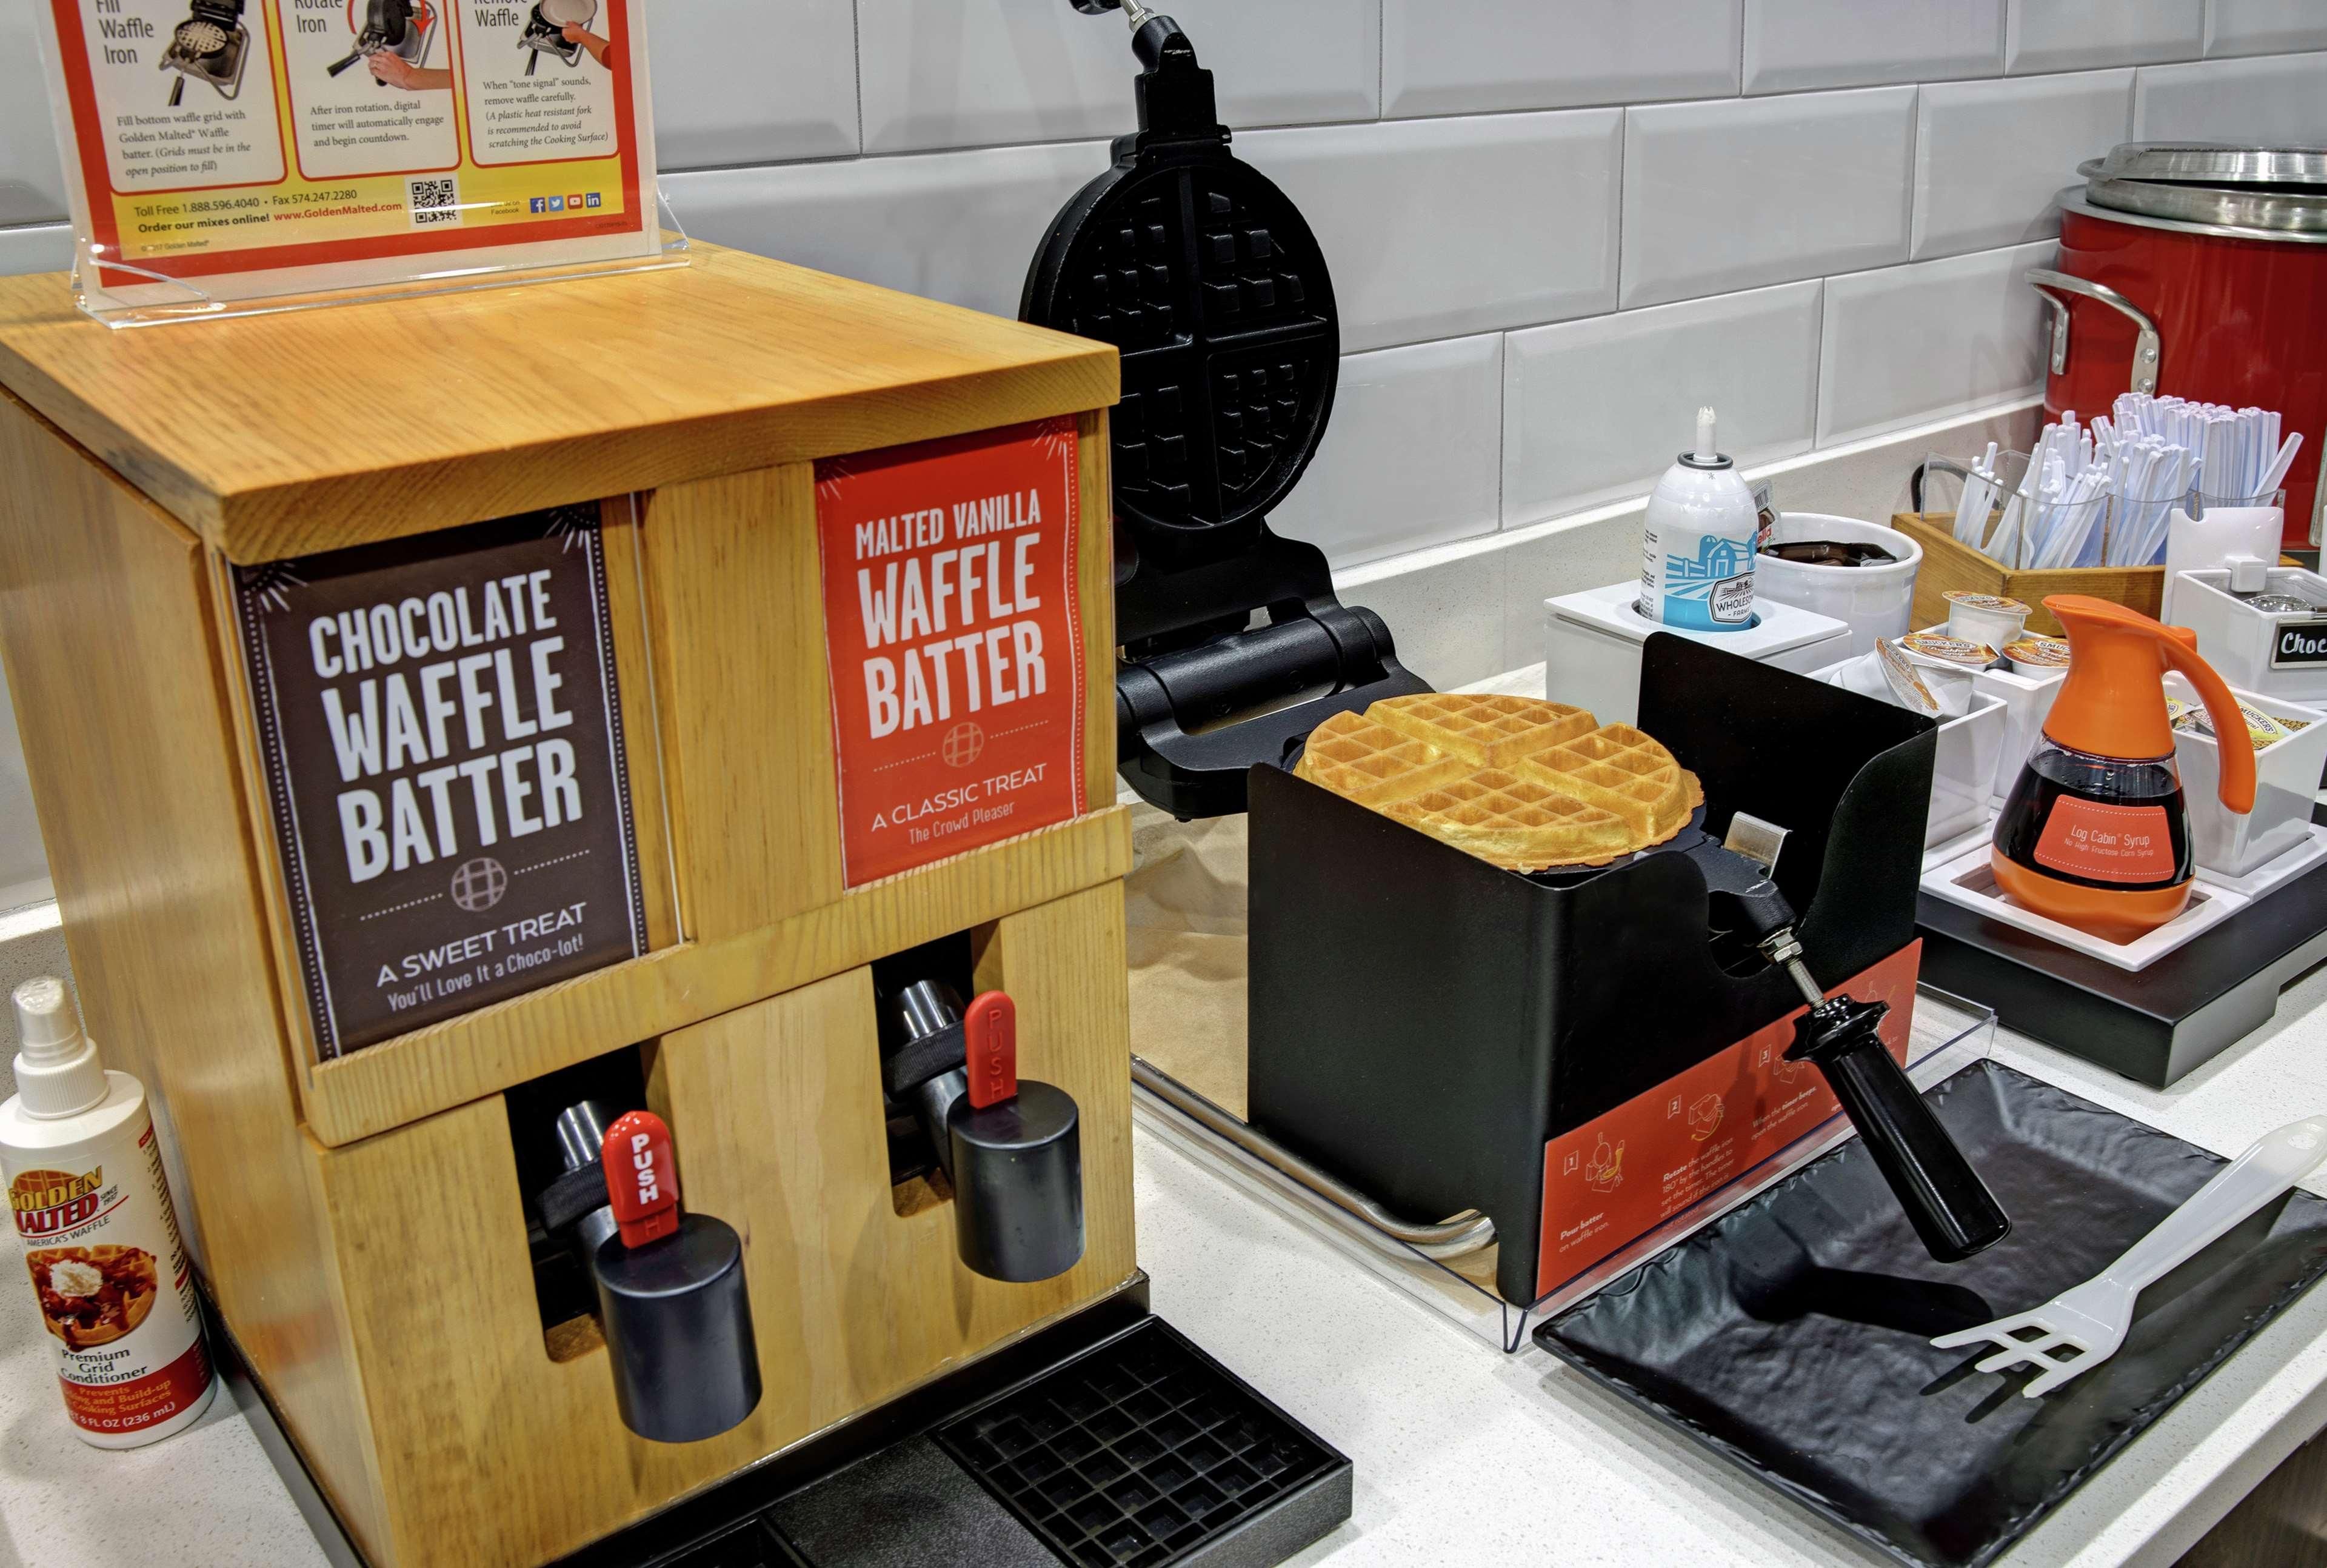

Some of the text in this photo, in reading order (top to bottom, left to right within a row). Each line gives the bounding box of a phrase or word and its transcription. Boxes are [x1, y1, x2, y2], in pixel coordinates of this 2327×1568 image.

[98, 18, 154, 39] Waffle
[296, 15, 327, 33] Iron
[475, 8, 519, 27] Waffle
[104, 44, 138, 64] Iron
[483, 81, 508, 90] When
[561, 76, 591, 86] sounds,
[310, 105, 332, 115] After
[335, 105, 353, 114] iron
[394, 100, 421, 113] digital
[484, 92, 576, 105] remove waffle carefully.
[117, 109, 246, 126] Fill bottom waffle grid with
[312, 116, 444, 131] timer will automatically engage
[486, 105, 592, 122] (A plastic heat resistant fork
[119, 132, 155, 144] Golden
[198, 127, 230, 138] Waffle
[487, 120, 582, 135] is recommended to avoid
[122, 142, 251, 160] batter. (Grids must be in the
[313, 133, 409, 147] and begin countdown.
[489, 132, 609, 148] scratching the Cooking Surface)
[125, 161, 217, 179] open position to fill)
[134, 189, 358, 217] Toll Free 1.888.596.4040 Fax 574.247.2280
[138, 202, 402, 233] Order our mixes online! www.GoldenMalted.com
[855, 489, 1041, 561] MALTED VANILLA
[857, 532, 1041, 649] WAFFLE
[308, 569, 557, 678] CHOCOLATE
[863, 619, 1047, 739] BATTER
[321, 635, 573, 782] WAFFLE
[871, 762, 1047, 832] A CLASSIC TREAT
[337, 738, 583, 883] BATTER
[909, 802, 1015, 844] The Crowd Pleaser
[2071, 824, 2150, 849] Log Syrup
[2075, 841, 2089, 852] High
[2091, 845, 2118, 856] Fructose
[2137, 849, 2154, 858] Syrup
[376, 901, 587, 988] A SWEET TREAT
[437, 973, 472, 996] Love
[477, 964, 490, 983] It
[495, 962, 504, 978] a
[507, 933, 584, 973] Choco-lot!
[988, 1009, 1004, 1099] PUSH
[1672, 1101, 1678, 1111] 2
[1752, 1096, 1799, 1127] When the timer
[1751, 1128, 1766, 1140] open
[1767, 1121, 1777, 1131] the
[1778, 1108, 1796, 1124] waffle
[631, 1133, 659, 1206] PUSH
[1569, 1157, 1574, 1166] 1
[1663, 1165, 1688, 1182] Rotate
[1688, 1158, 1700, 1167] the
[1701, 1144, 1720, 1160] waffle
[1679, 1175, 1688, 1184] by
[1689, 1169, 1700, 1179] the
[1701, 1154, 1725, 1172] handles
[1661, 1196, 1672, 1207] set
[1673, 1189, 1684, 1199] the
[70, 1215, 111, 1239] WAFFLE
[1560, 1212, 1604, 1240] Pour batter
[1559, 1243, 1569, 1253] on
[1571, 1228, 1593, 1246] waffle
[62, 1349, 130, 1362] Premium
[61, 1366, 147, 1384] Conditioner
[79, 1361, 115, 1374] Grid
[79, 1386, 130, 1396] Prevents
[93, 1395, 115, 1405] and
[118, 1380, 172, 1403] Build-up
[118, 1390, 172, 1413] Surfaces
[88, 1418, 101, 1427] FL
[102, 1419, 121, 1428] OZ
[122, 1412, 150, 1427] (236
[153, 1401, 176, 1418] mL)
